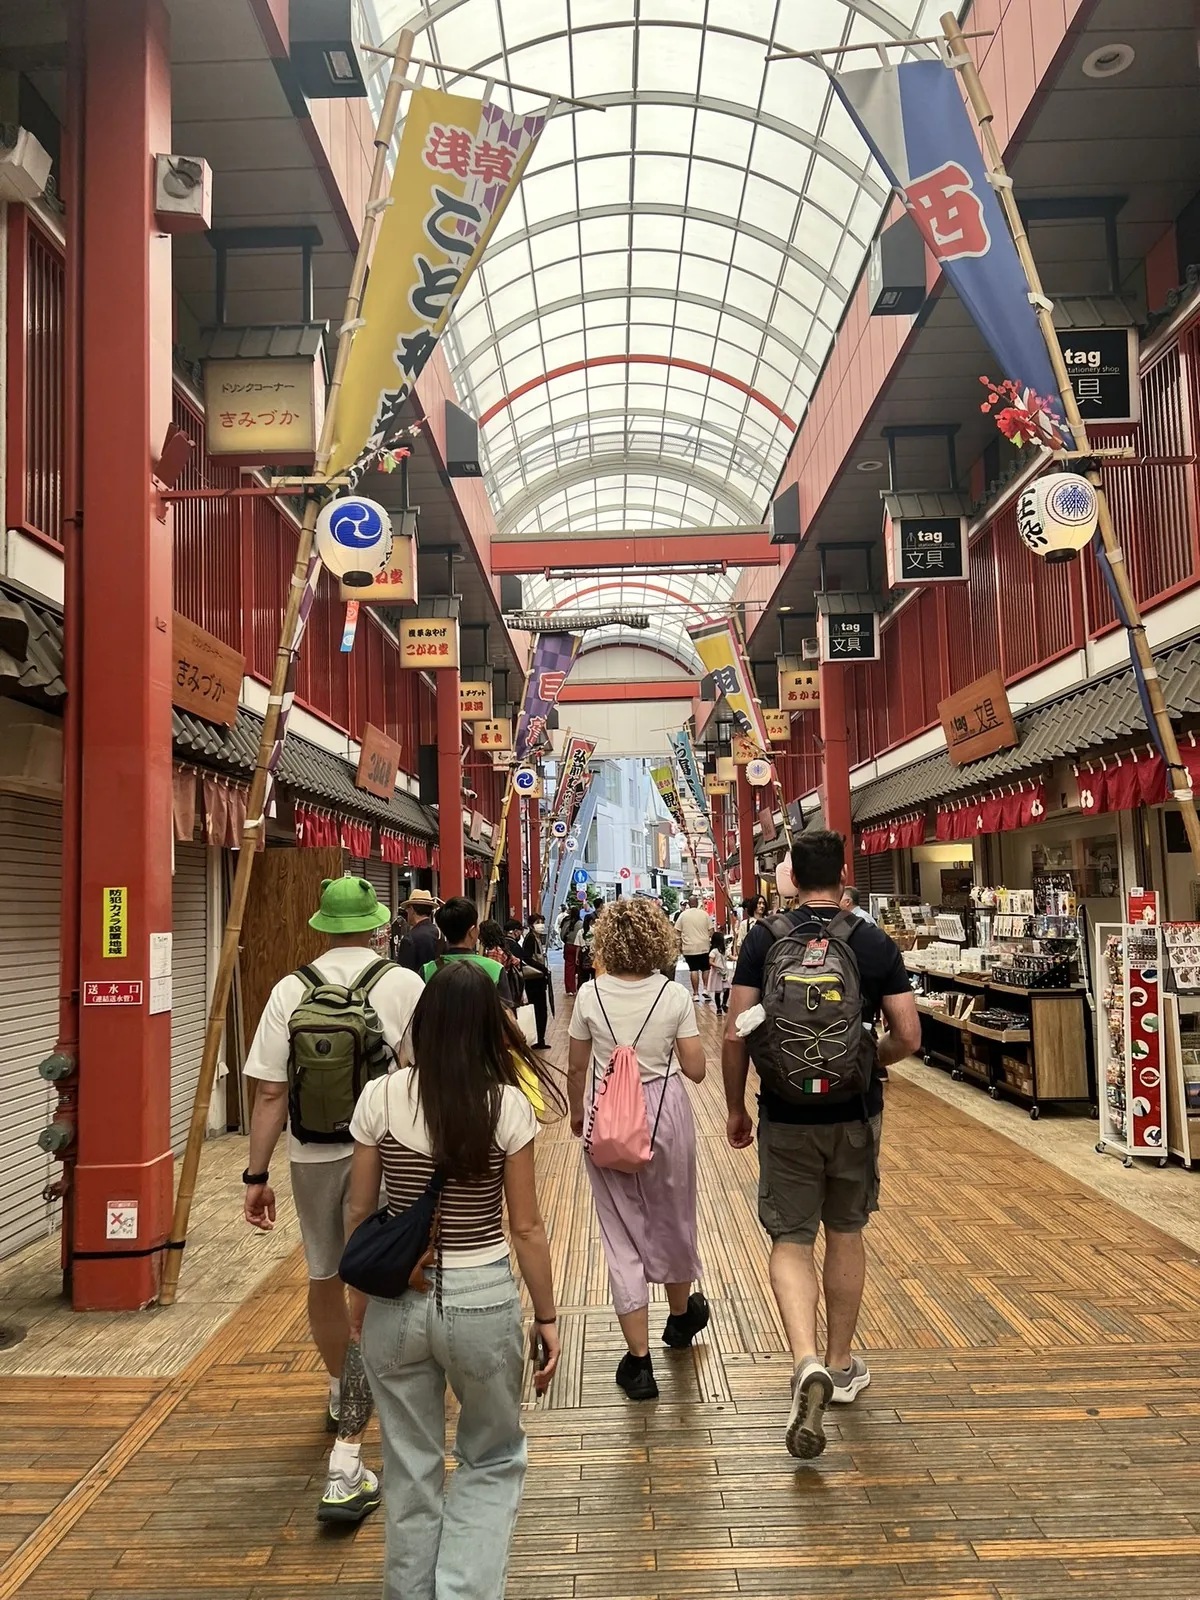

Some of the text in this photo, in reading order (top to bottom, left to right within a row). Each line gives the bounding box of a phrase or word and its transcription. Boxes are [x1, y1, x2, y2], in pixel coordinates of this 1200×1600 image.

[425, 126, 517, 184] 浅草
[1064, 348, 1101, 368] tag
[1067, 365, 1120, 375] tationery shop
[222, 383, 295, 393] ドリンクコーナー
[1070, 378, 1103, 406] 具
[219, 409, 300, 428] きみづか
[917, 530, 943, 543] tag
[905, 550, 945, 570] 文具
[841, 622, 860, 633] tag
[406, 643, 449, 656] こがね堂
[832, 638, 862, 652] 文具
[176, 657, 225, 702] きみづか
[465, 689, 487, 698] チケット
[974, 698, 999, 733] 文具
[108, 889, 122, 955] 防犯カメラ設置地域
[87, 984, 140, 995] 送水口
